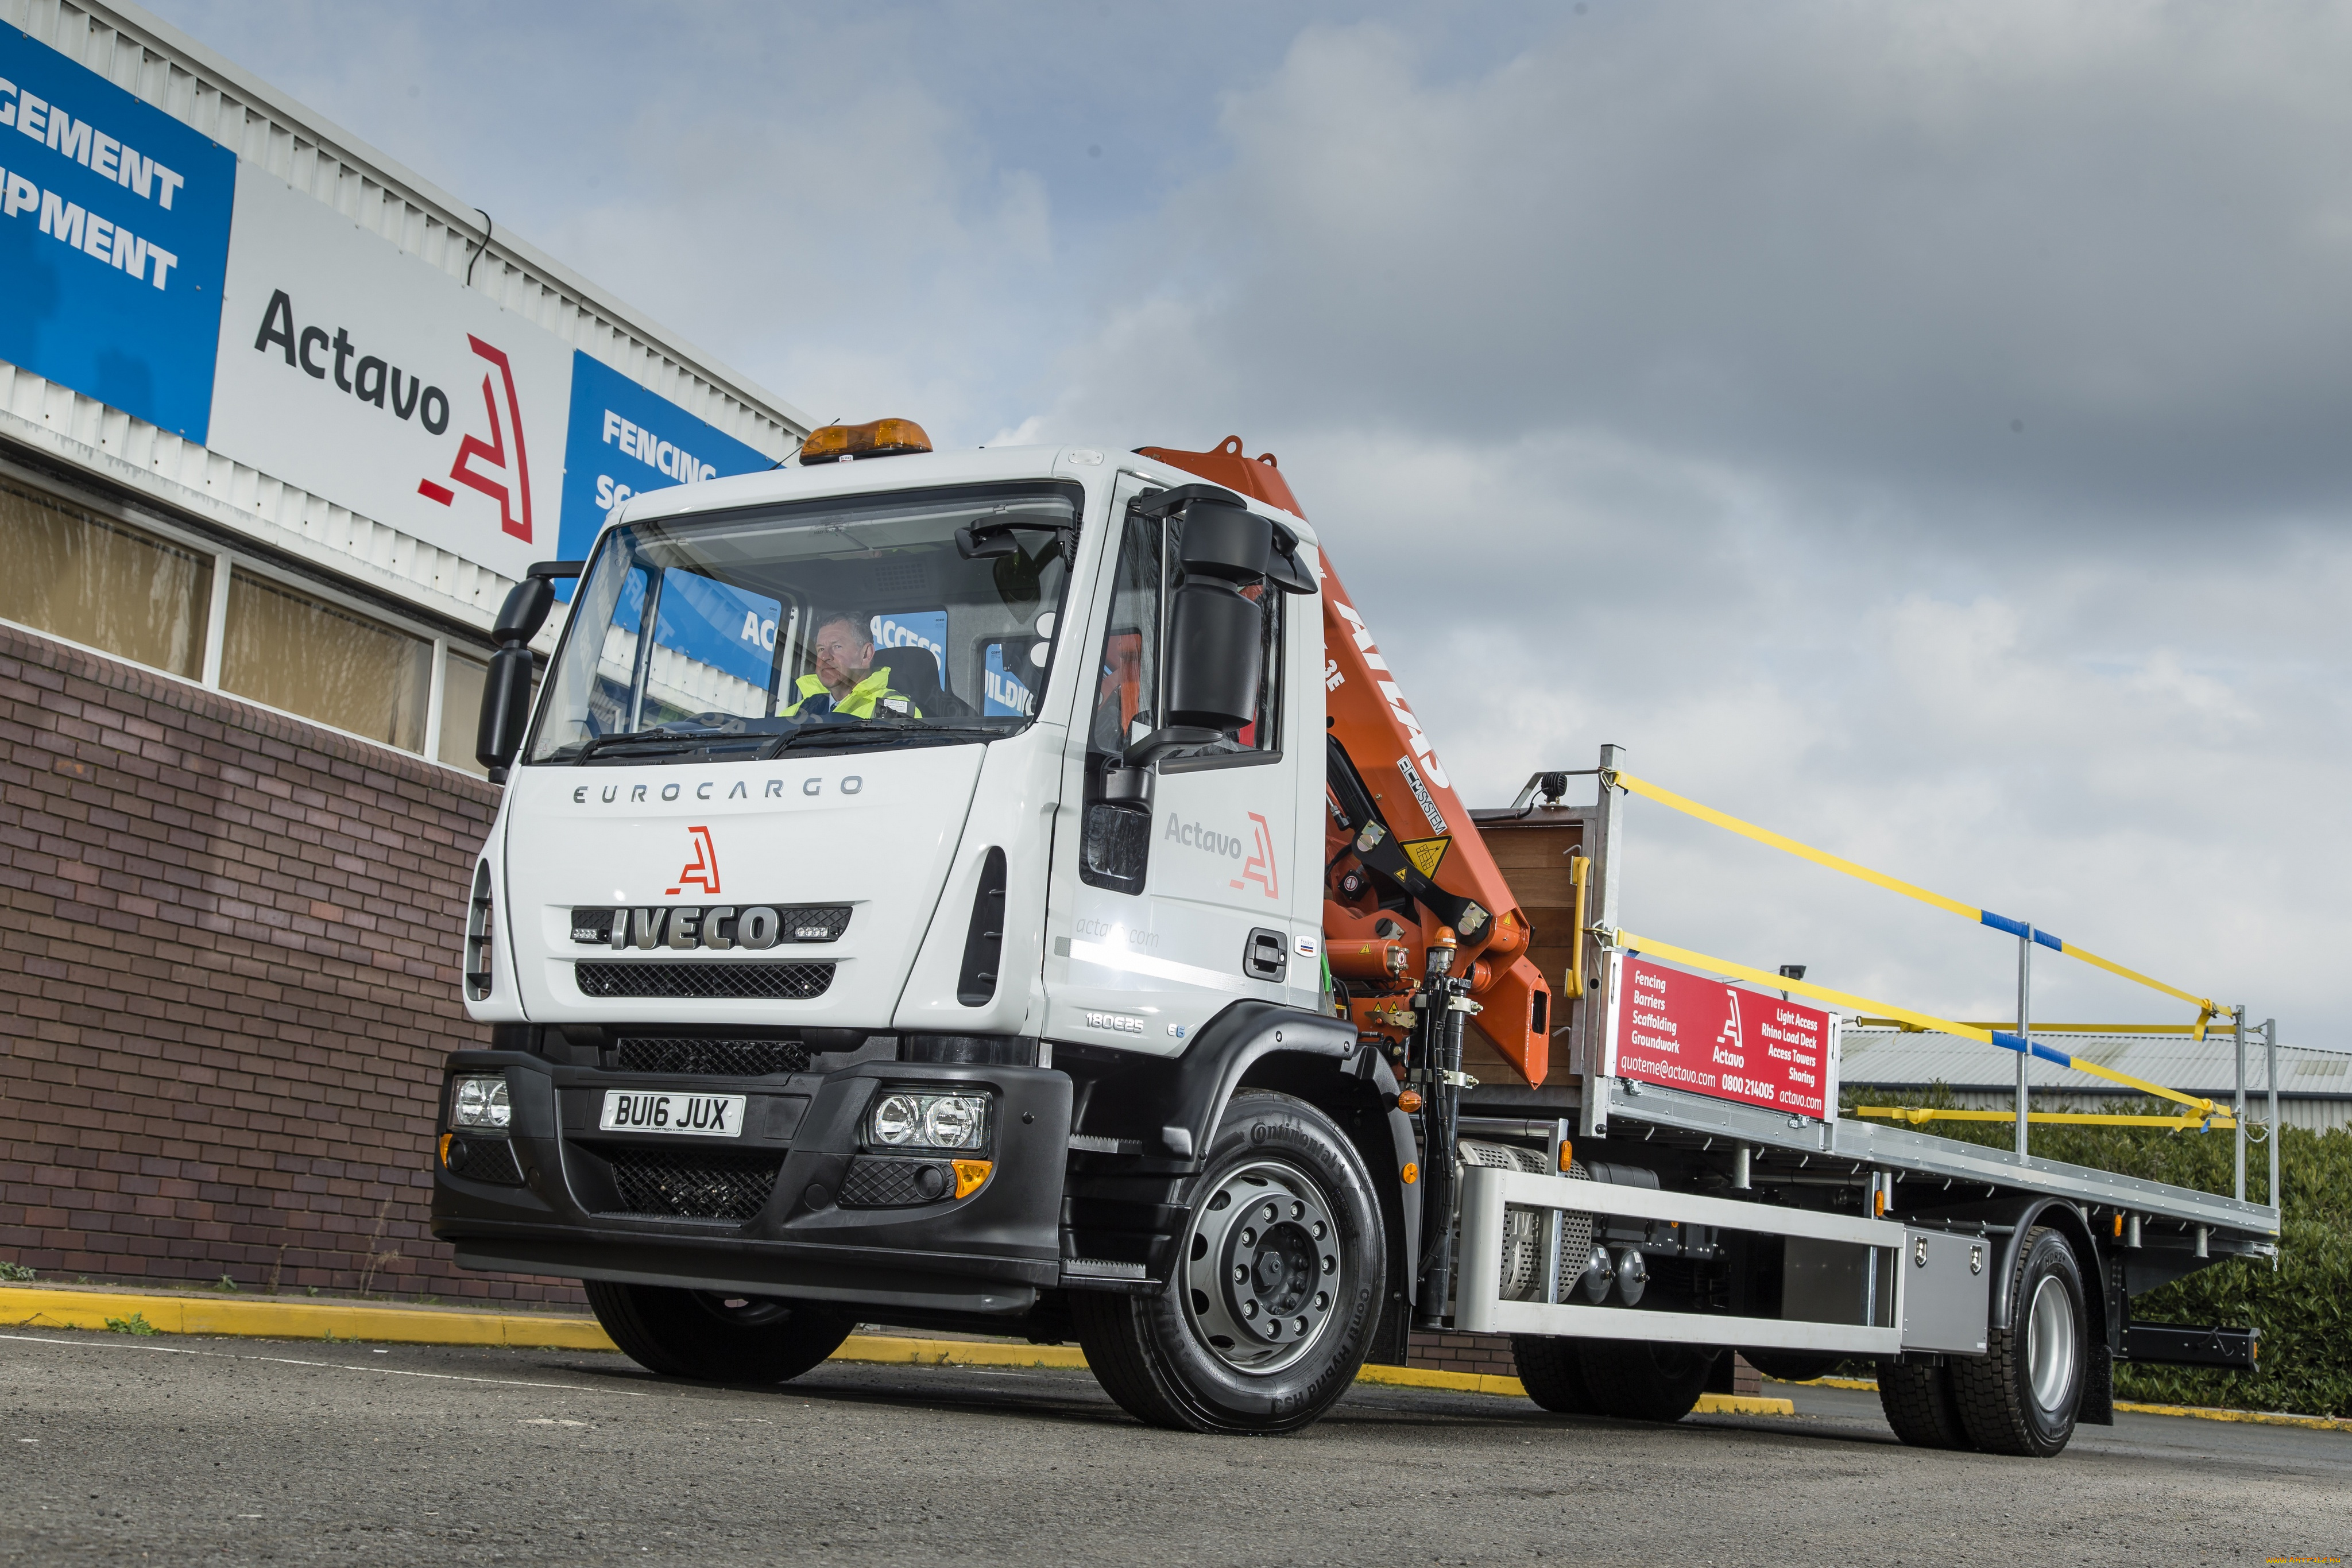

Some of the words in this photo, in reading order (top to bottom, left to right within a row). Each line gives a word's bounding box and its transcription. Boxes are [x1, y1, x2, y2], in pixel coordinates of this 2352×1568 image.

[254, 288, 449, 435] Actavo
[573, 775, 864, 804] EUROCARGO
[1165, 812, 1242, 860] Actavo
[611, 906, 782, 951] IVECO
[1300, 938, 1314, 947] Fraikin
[1635, 970, 1666, 993] Fencing
[1634, 990, 1665, 1011] Barriers
[1085, 1012, 1144, 1033] 180E25
[1167, 1023, 1186, 1037] E6
[1633, 1010, 1677, 1035] Scaffolding
[1777, 1008, 1794, 1025] Light
[1795, 1014, 1817, 1031] Access
[1631, 1030, 1680, 1054] Groundwork
[1762, 1023, 1782, 1040] Rhino
[1783, 1031, 1800, 1044] Load
[1800, 1035, 1817, 1049] Deck
[1712, 1046, 1744, 1068] Actavo
[1769, 1044, 1791, 1061] Access
[1792, 1050, 1816, 1067] Towers
[1621, 1056, 1716, 1087] quoteme@actavo.com
[1789, 1067, 1815, 1087] Shoring
[1722, 1074, 1743, 1093] 0800
[1745, 1078, 1774, 1099] 214005
[1780, 1090, 1821, 1110] actavo.com
[614, 1095, 670, 1126] BU16
[676, 1098, 729, 1130] JUX
[1250, 1121, 1338, 1170] Continental
[1347, 1288, 1370, 1342] Conti
[1306, 1345, 1351, 1399] Hybrid
[1275, 1391, 1305, 1414] HS3
